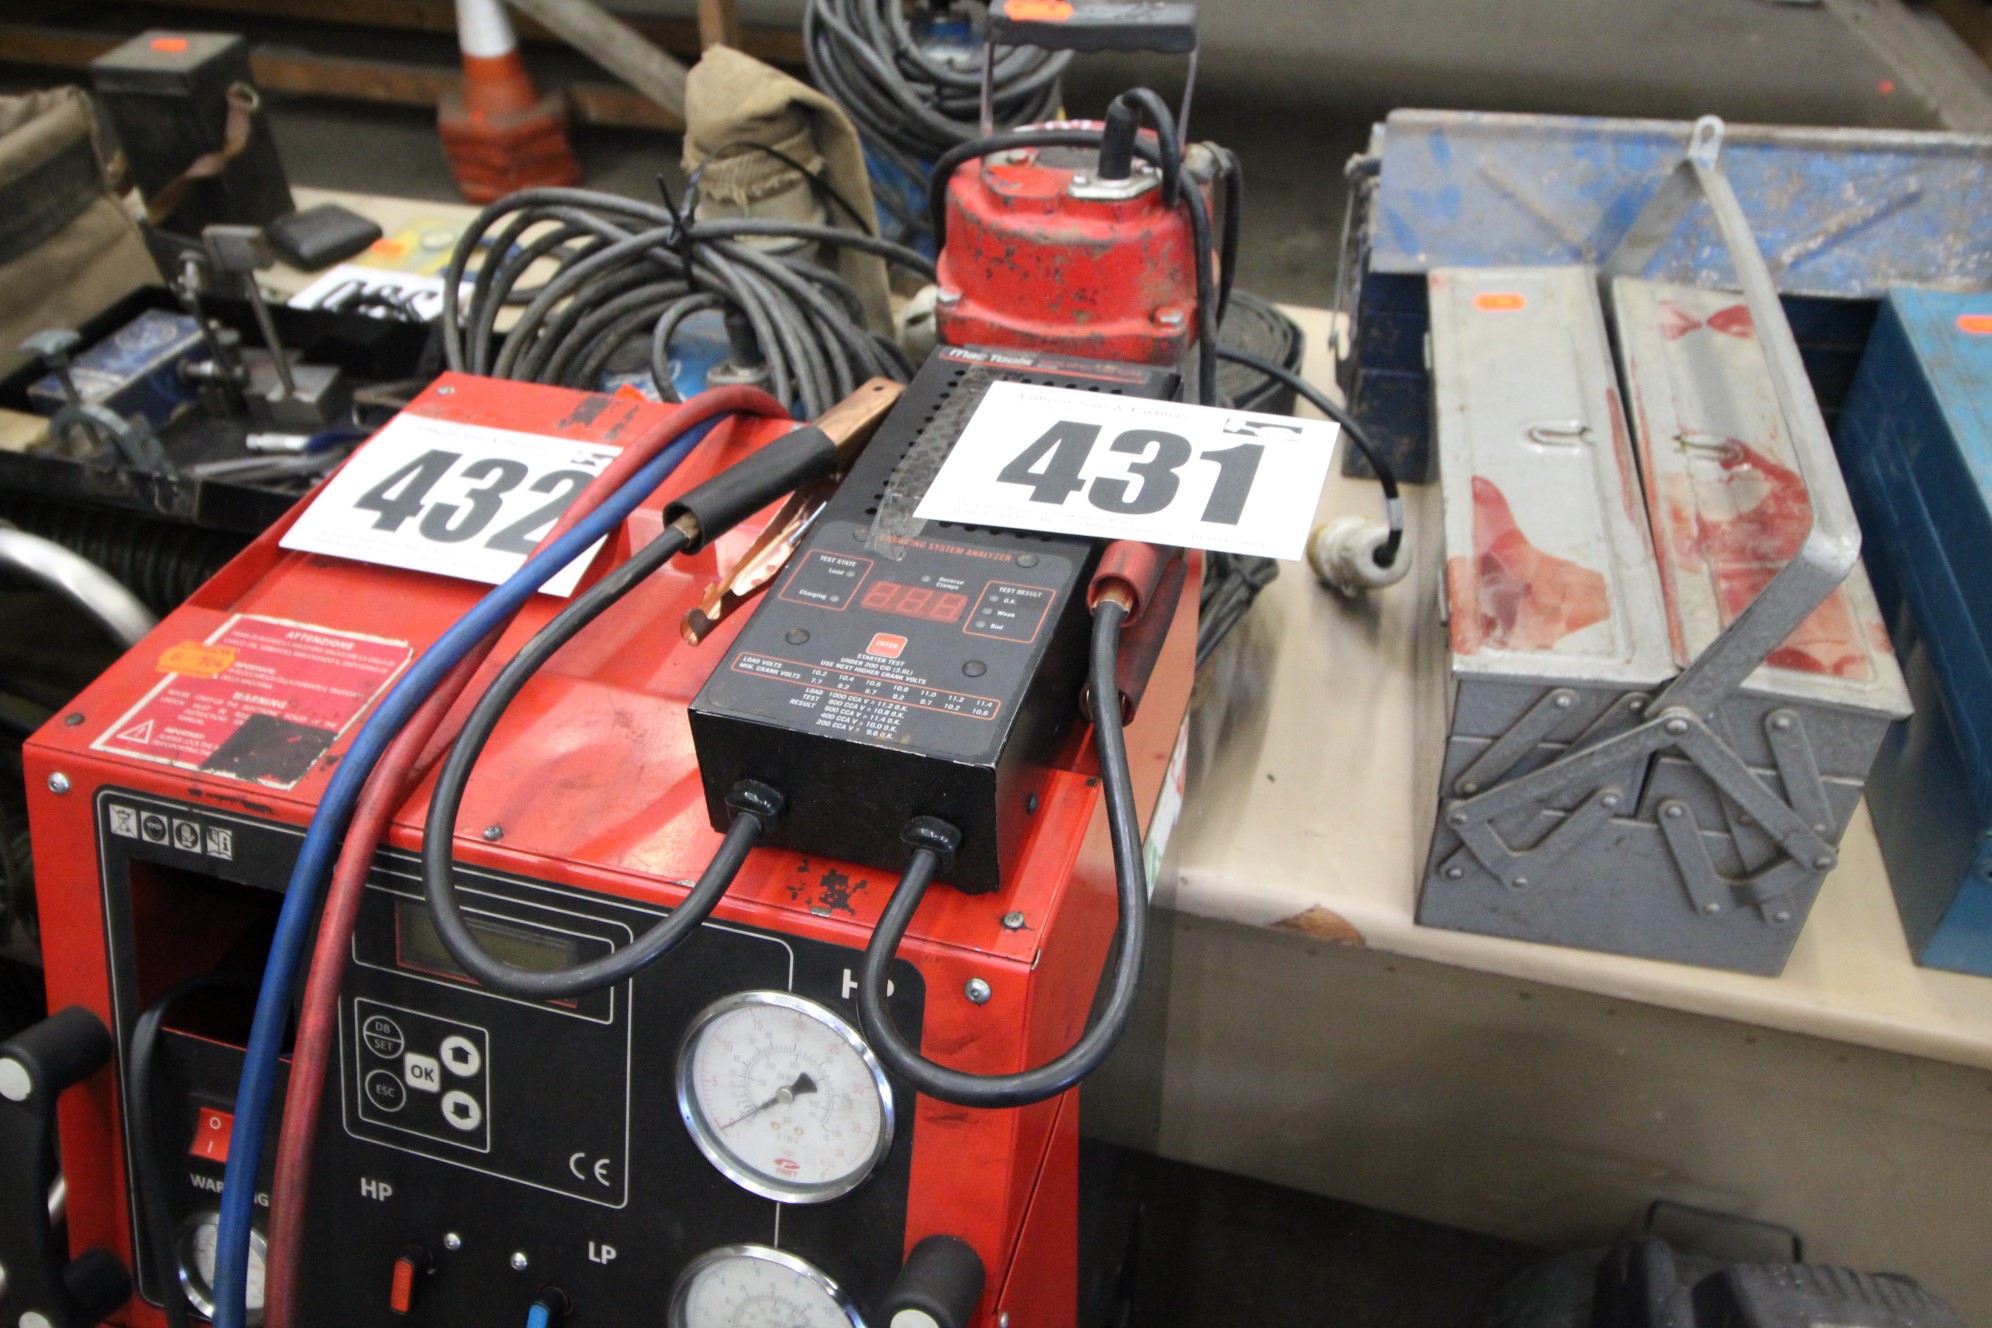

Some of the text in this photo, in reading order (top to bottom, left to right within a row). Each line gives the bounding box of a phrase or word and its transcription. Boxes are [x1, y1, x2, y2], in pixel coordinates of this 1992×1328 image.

[996, 420, 1265, 525] 431
[352, 449, 598, 555] 432
[928, 543, 964, 555] SYSTEM
[965, 549, 1012, 561] ANALYZER
[819, 555, 857, 567] TEST STATE
[828, 568, 844, 576] Load
[936, 582, 959, 591] Clamps
[938, 576, 965, 586] Reverse
[799, 589, 827, 600] Charging
[999, 586, 1043, 598] TEST RESULT
[997, 610, 1015, 618] Weak
[286, 630, 356, 650] ATTENZIONE
[875, 640, 899, 649] ENTER
[840, 657, 864, 667] UNDER
[857, 653, 906, 667] STARTER TEST
[820, 660, 927, 685] USE NEXT HIGHER CRANK VOLTS
[739, 662, 754, 670] MIN.
[756, 664, 779, 675] CRANK
[780, 670, 801, 679] VOLTS
[944, 703, 961, 711] 10.2
[742, 656, 761, 664] LOAD
[762, 659, 783, 668] VOLTS
[812, 669, 828, 677] 10.2
[838, 674, 854, 682] 10.4
[921, 690, 937, 698] 11.0
[949, 695, 965, 703] 11.2
[976, 700, 993, 708] 11.4
[233, 691, 287, 709] WARNING
[802, 694, 820, 702] TEST
[844, 702, 858, 710] CCA
[805, 687, 824, 696] LOAD
[828, 692, 847, 700] 1000
[848, 695, 862, 703] CCA
[877, 701, 893, 709] 11.2
[789, 699, 817, 709] RESULT
[840, 708, 855, 716] CCA
[816, 719, 831, 727] 200
[832, 722, 846, 730] CCA
[836, 715, 850, 723] CCA
[866, 722, 882, 730] 10.0
[842, 968, 895, 999] H
[375, 1021, 391, 1034] DB
[374, 1039, 392, 1052] SET
[410, 1064, 435, 1082] OK
[376, 1084, 395, 1098] ESC
[360, 1177, 393, 1202] HP
[588, 1241, 617, 1265] LP
